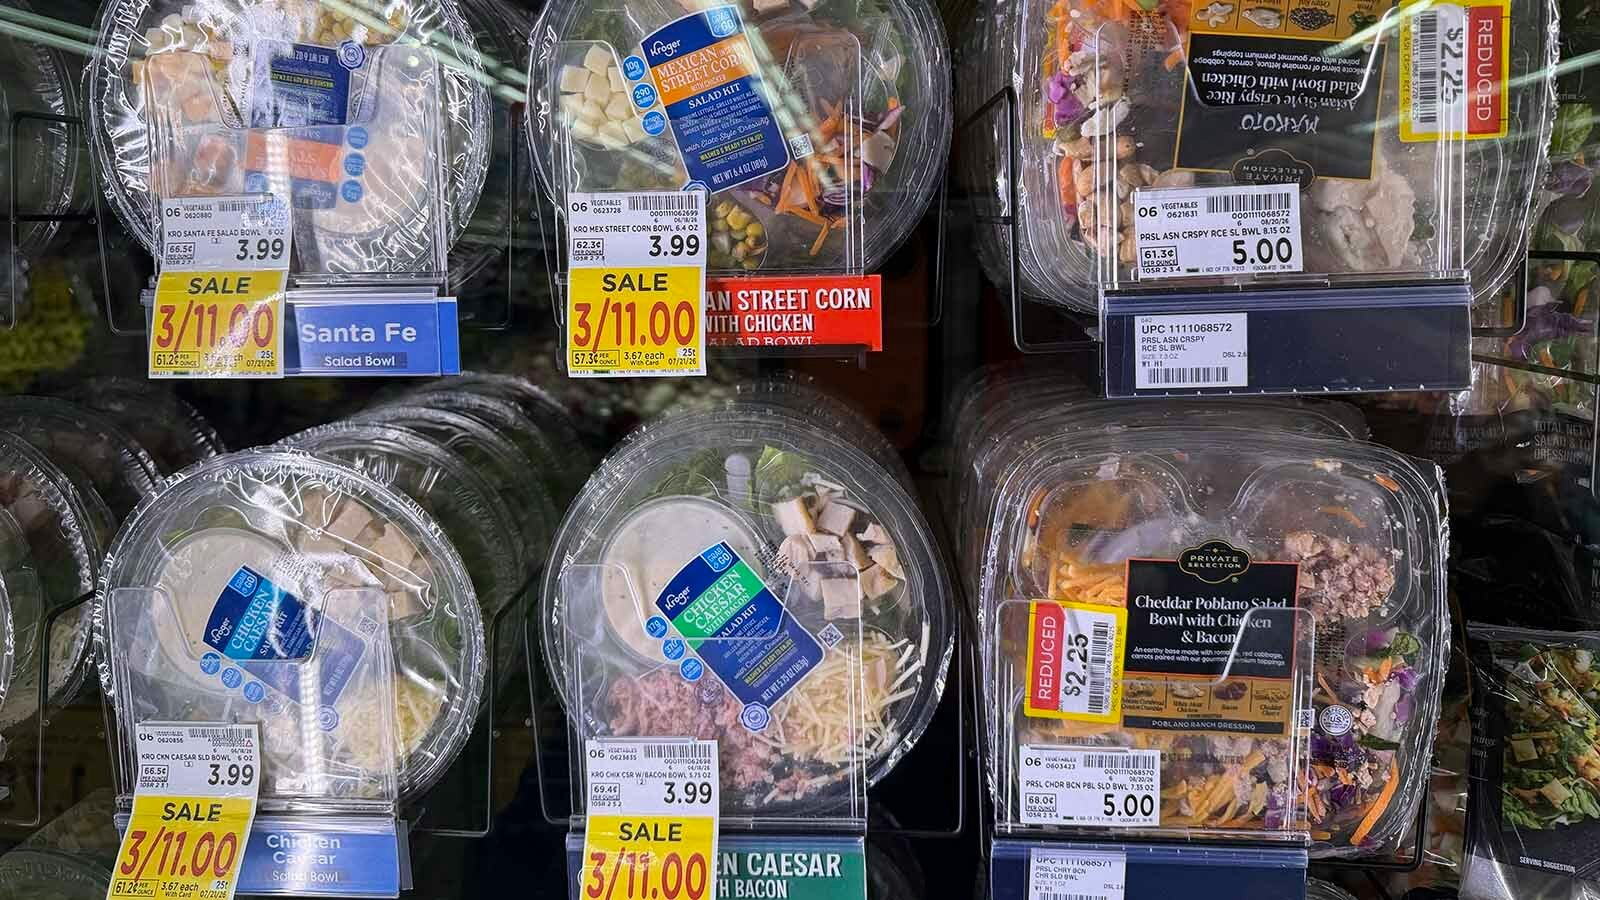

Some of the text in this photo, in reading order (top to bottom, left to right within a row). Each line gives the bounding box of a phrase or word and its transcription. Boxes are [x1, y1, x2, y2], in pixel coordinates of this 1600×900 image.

[650, 40, 681, 56] Kroger
[657, 47, 718, 80] MEXICAN
[1476, 20, 1493, 120] REDUCED
[661, 66, 709, 92] STREET
[1202, 73, 1257, 90] Chicken
[1260, 76, 1288, 90] with
[1292, 78, 1327, 91] Bowl
[634, 87, 650, 98] 290
[688, 82, 740, 109] SALAD KIT
[1206, 90, 1317, 108] Style Crispy Rice
[712, 170, 734, 184] NET WT
[166, 208, 180, 217] 06
[571, 202, 588, 212] 06
[1138, 207, 1158, 218] 06
[1232, 211, 1290, 219] 0001111068572
[1140, 232, 1160, 241] PRSL
[1162, 232, 1179, 240] ASN
[1182, 230, 1208, 239] CRSPY
[1211, 229, 1227, 238] RCE
[1242, 228, 1261, 236] BWL
[236, 238, 284, 260] 3.99
[649, 234, 699, 257] 3.99
[1145, 250, 1174, 259] 61.3¢
[1233, 237, 1292, 265] 5.00
[188, 277, 251, 294] SALE
[602, 273, 668, 292] SALE
[737, 288, 871, 310] STREET CORN
[156, 300, 273, 353] 3/11.00
[574, 298, 695, 353] 3/11.00
[744, 314, 813, 332] CHICKEN
[1142, 324, 1232, 334] UPC 1111068572
[301, 323, 417, 342] Santa Fe
[156, 353, 179, 365] 61.2¢
[324, 355, 396, 367] Salad Bowl
[574, 353, 598, 364] 57.3¢
[624, 352, 642, 360] 3.67
[683, 348, 695, 356] 25t
[718, 552, 730, 565] GO
[665, 586, 691, 610] Kroger
[683, 569, 742, 623] CHICKEN
[1136, 595, 1286, 610] Cheddar Poblano Salad
[695, 582, 746, 629] CAESAR
[704, 592, 750, 635] WITH BACON
[743, 604, 757, 619] KIT
[231, 588, 269, 649] CHICKEN
[1149, 614, 1272, 628] Bowl with Chicken
[211, 618, 230, 644] Kroger
[1181, 631, 1237, 644] & Bacon
[1038, 616, 1056, 700] REDUCED
[1064, 634, 1088, 696] $2.25
[589, 750, 605, 758] 06
[1025, 757, 1041, 766] 06
[208, 764, 253, 785] 3.99
[664, 782, 712, 804] 3.99
[161, 803, 222, 821] SALE
[1103, 794, 1154, 816] 5.00
[619, 823, 682, 842] SALE
[121, 826, 237, 882] 3/11.00
[587, 847, 706, 900] 3/11.00
[746, 852, 842, 877] CAESAR
[1520, 856, 1576, 873] SERVING SUGGESTION
[311, 871, 339, 882] Bowl
[115, 881, 137, 894] 61.2¢
[161, 881, 198, 891] 3.67 each
[736, 880, 787, 898] BACON
